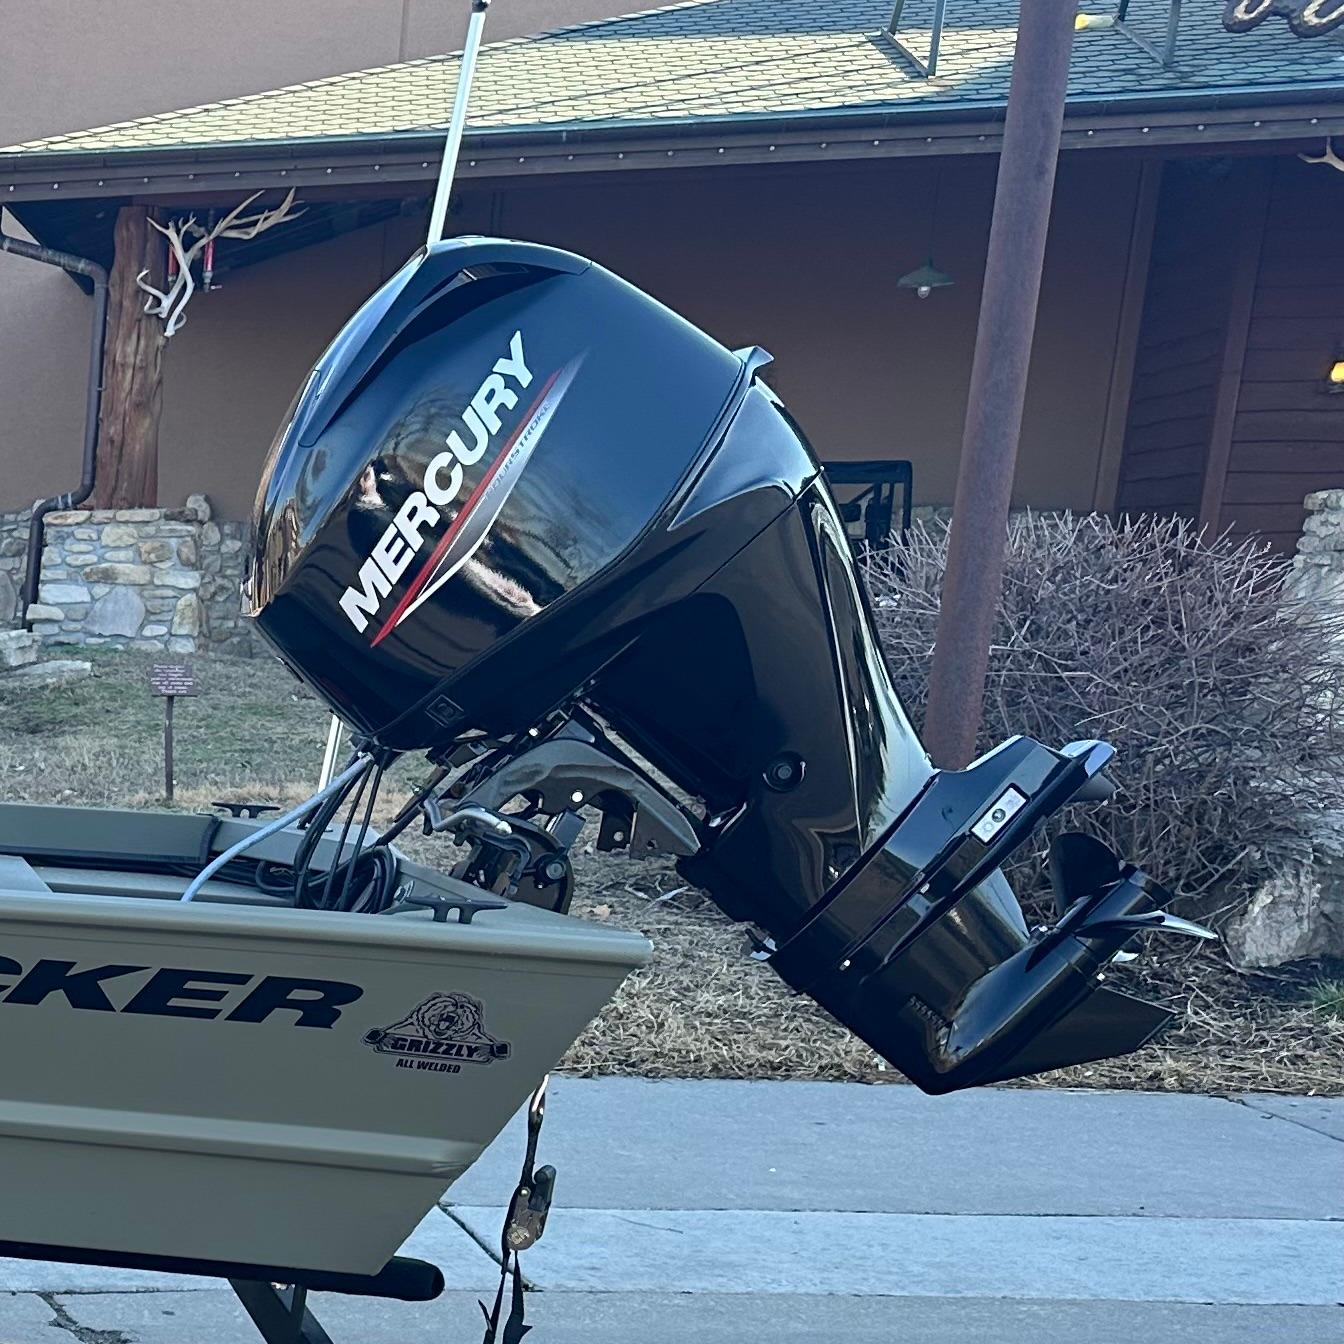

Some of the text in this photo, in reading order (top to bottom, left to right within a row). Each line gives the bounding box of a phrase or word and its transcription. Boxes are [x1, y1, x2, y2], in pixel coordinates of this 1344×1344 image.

[339, 330, 533, 633] MERCURY
[390, 1037, 481, 1059] GRIZZLY
[395, 1058, 461, 1074] ALL WELDED
